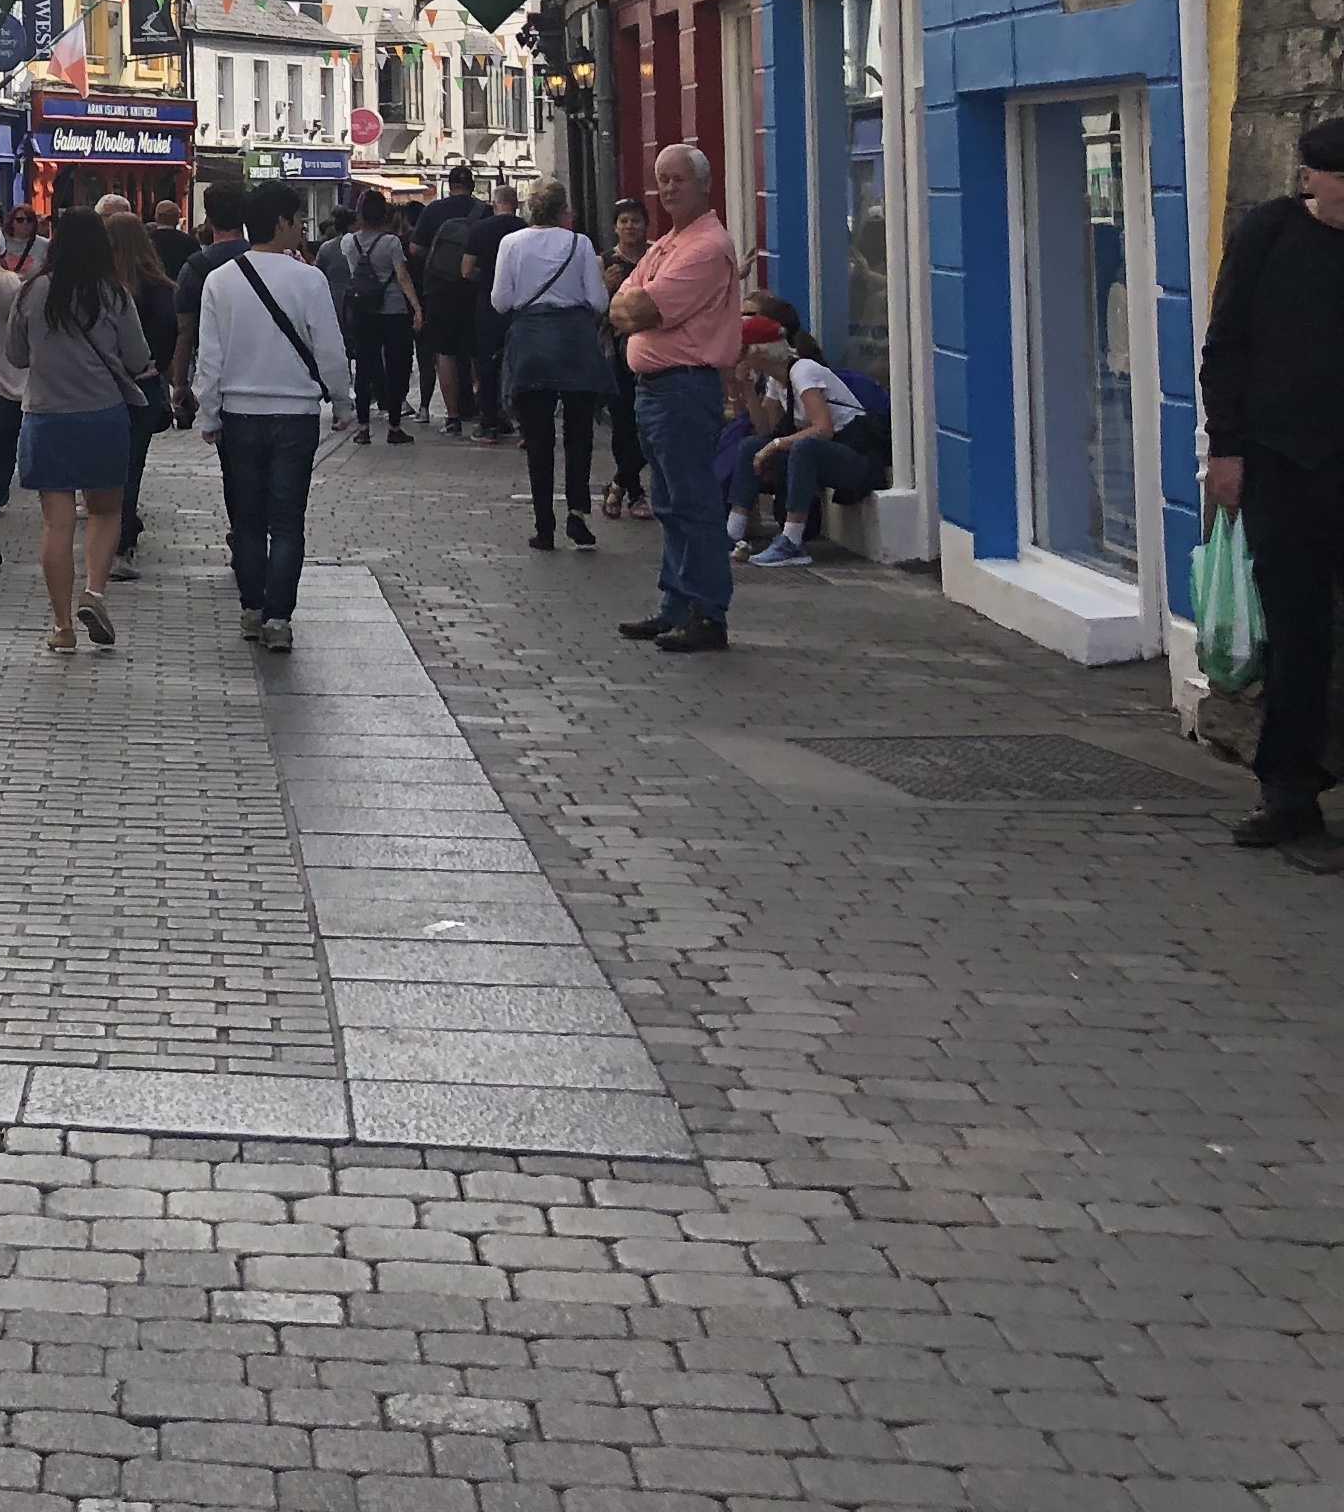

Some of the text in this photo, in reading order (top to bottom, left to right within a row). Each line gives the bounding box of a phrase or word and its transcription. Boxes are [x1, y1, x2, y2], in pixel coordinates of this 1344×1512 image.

[87, 103, 104, 115] ARAN
[53, 127, 172, 157] Galway Woollen Market
